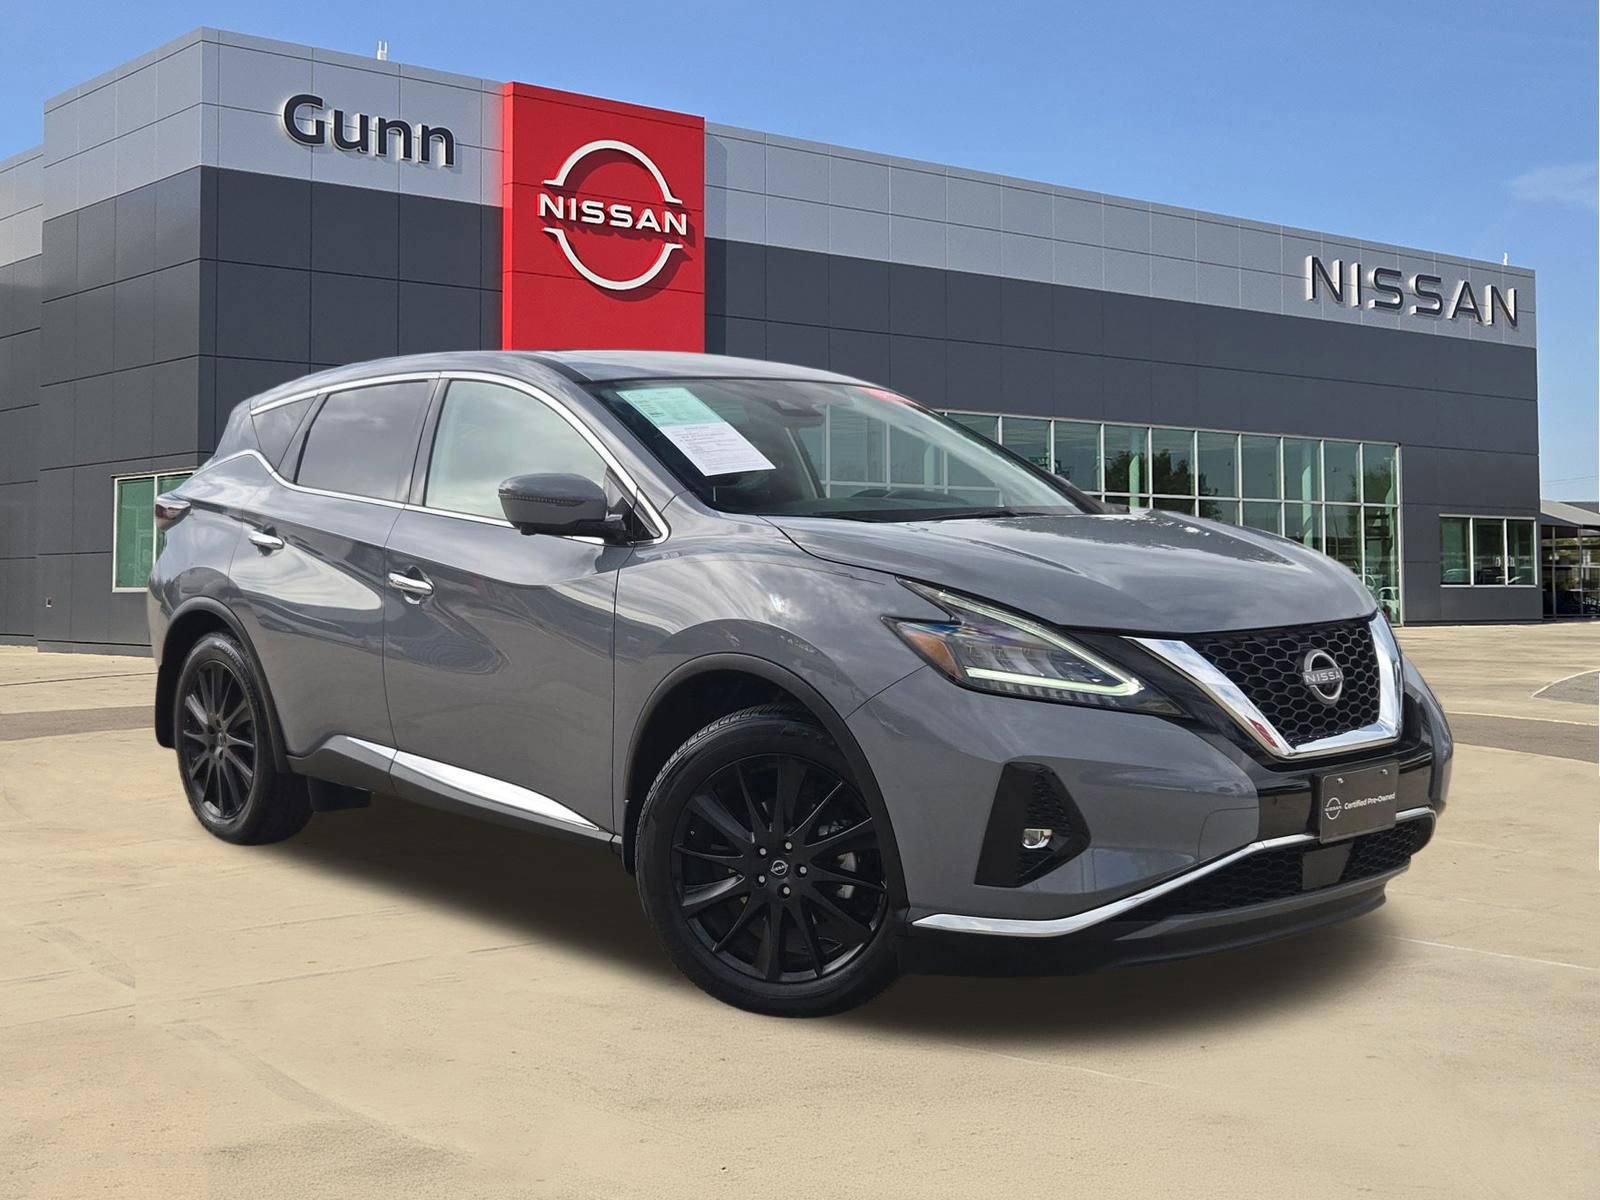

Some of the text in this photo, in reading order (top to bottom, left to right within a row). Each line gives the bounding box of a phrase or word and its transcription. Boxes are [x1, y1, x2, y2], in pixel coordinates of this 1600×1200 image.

[282, 93, 456, 168] Gunn
[537, 193, 688, 236] NISSAN
[1305, 255, 1518, 327] NISSAN
[1304, 670, 1343, 683] NISSA
